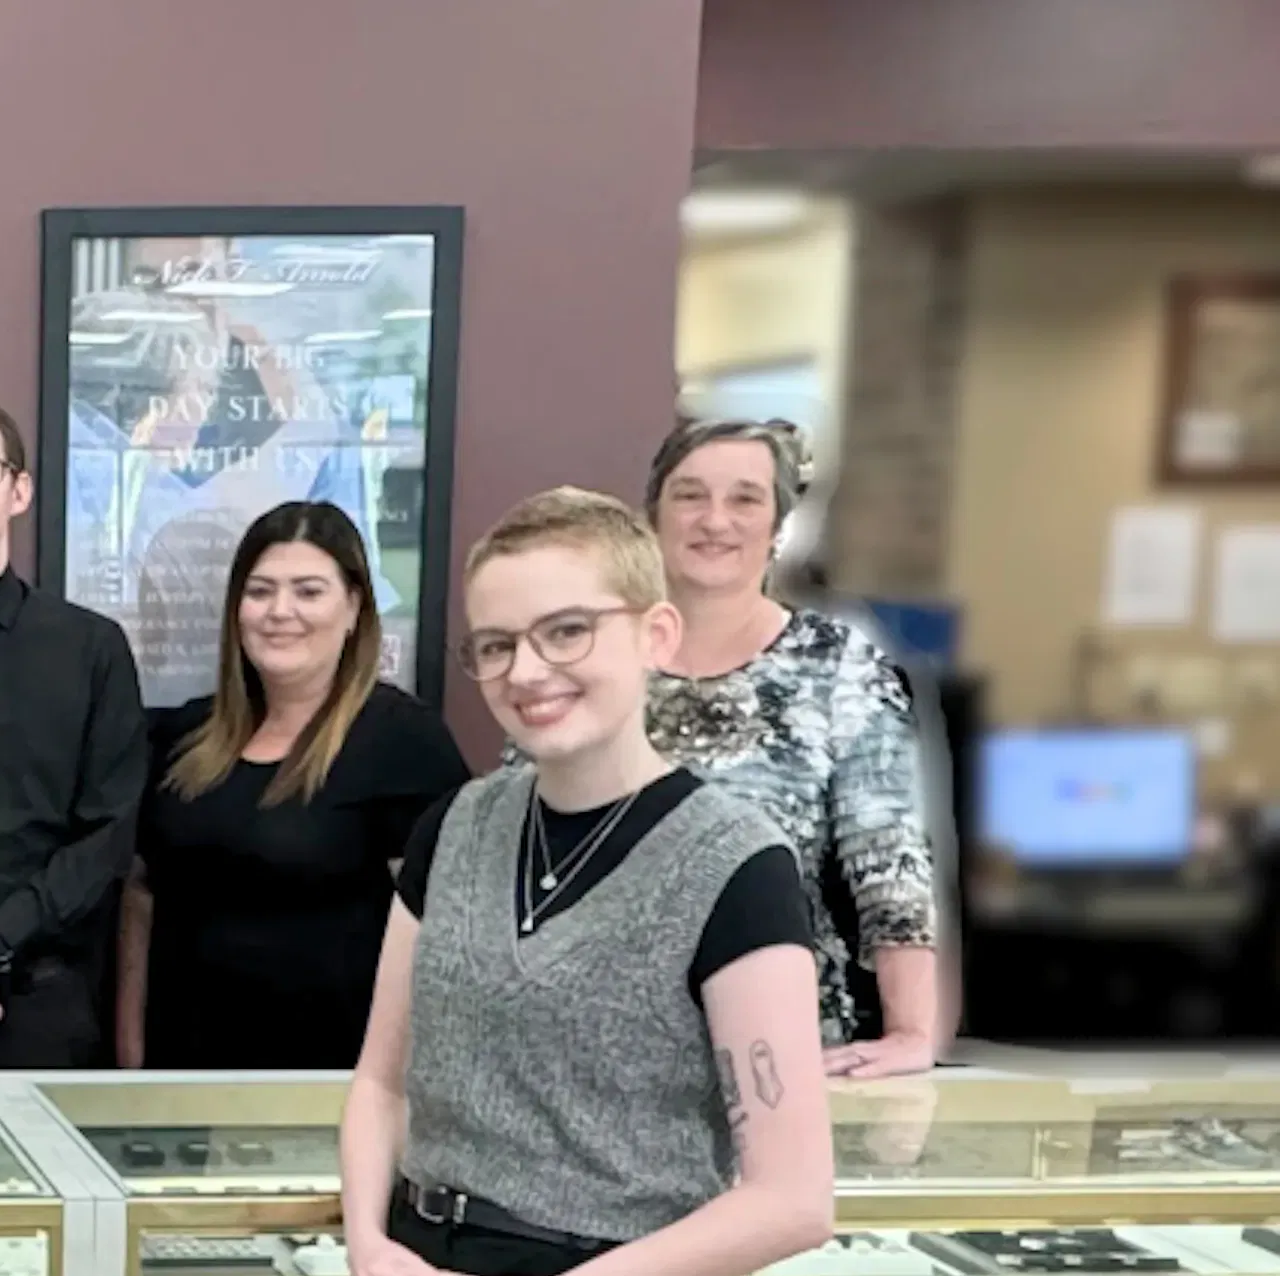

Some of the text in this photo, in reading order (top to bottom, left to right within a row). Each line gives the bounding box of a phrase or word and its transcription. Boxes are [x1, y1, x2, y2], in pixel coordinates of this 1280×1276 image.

[173, 344, 325, 370] YOUR BIG
[148, 395, 349, 422] DAY STARTS
[176, 447, 261, 473] WITH
